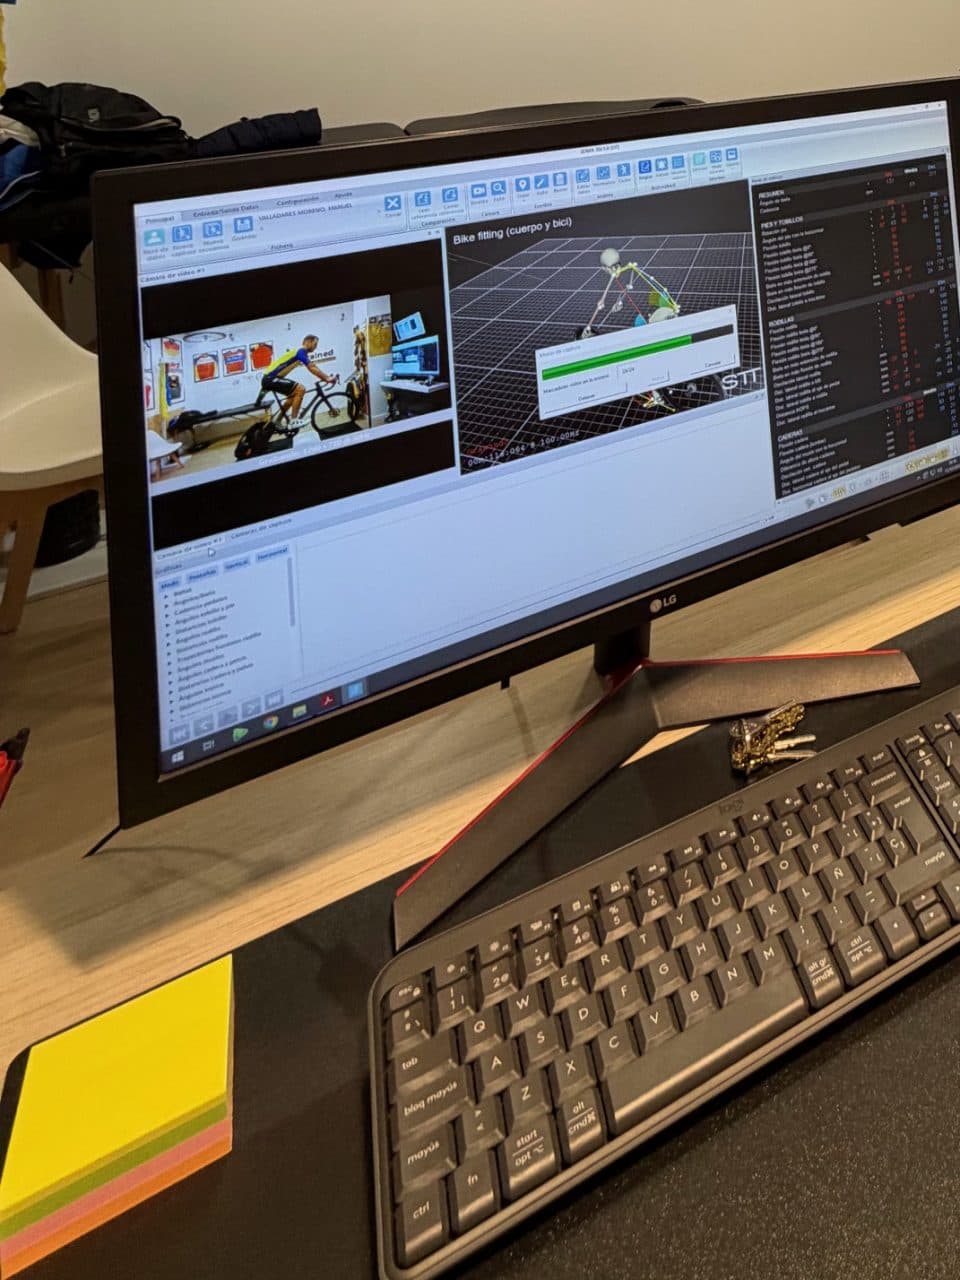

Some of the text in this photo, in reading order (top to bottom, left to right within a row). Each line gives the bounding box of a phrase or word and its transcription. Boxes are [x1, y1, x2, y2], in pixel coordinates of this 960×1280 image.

[453, 216, 573, 245] Bike fitting (cuerpo y bici)
[663, 594, 677, 608] LG
[786, 827, 793, 837] 0
[753, 844, 760, 853] 9
[811, 842, 820, 853] P
[779, 860, 789, 871] O
[833, 866, 844, 880] Ñ
[685, 878, 692, 888] 7
[801, 886, 811, 898] L
[711, 894, 721, 906] U
[767, 903, 778, 916] K
[613, 916, 621, 926] 5
[676, 914, 684, 926] Y
[734, 922, 742, 935] J
[575, 935, 582, 945] 4
[639, 933, 647, 945] T
[695, 942, 707, 957] H
[762, 946, 776, 961] M
[535, 955, 543, 966] 3
[600, 953, 611, 967] R
[658, 962, 670, 975] G
[726, 967, 738, 981] N
[560, 974, 569, 988] E
[620, 984, 629, 998] F
[689, 989, 700, 1003] B
[515, 994, 530, 1010] W
[577, 1007, 590, 1021] D
[649, 1011, 660, 1025] V
[473, 1020, 487, 1034] Q
[536, 1030, 546, 1044] S
[608, 1035, 620, 1049] C
[401, 1057, 418, 1071] tab
[490, 1055, 503, 1070] A
[565, 1059, 577, 1074] X
[403, 1081, 458, 1117] bloq mayús
[520, 1085, 532, 1101] Z
[572, 1100, 585, 1114] alt
[515, 1128, 538, 1147] start
[406, 1139, 441, 1166] mayús
[514, 1152, 532, 1167] opt
[466, 1173, 479, 1187] fn
[411, 1201, 430, 1220] ctrl
